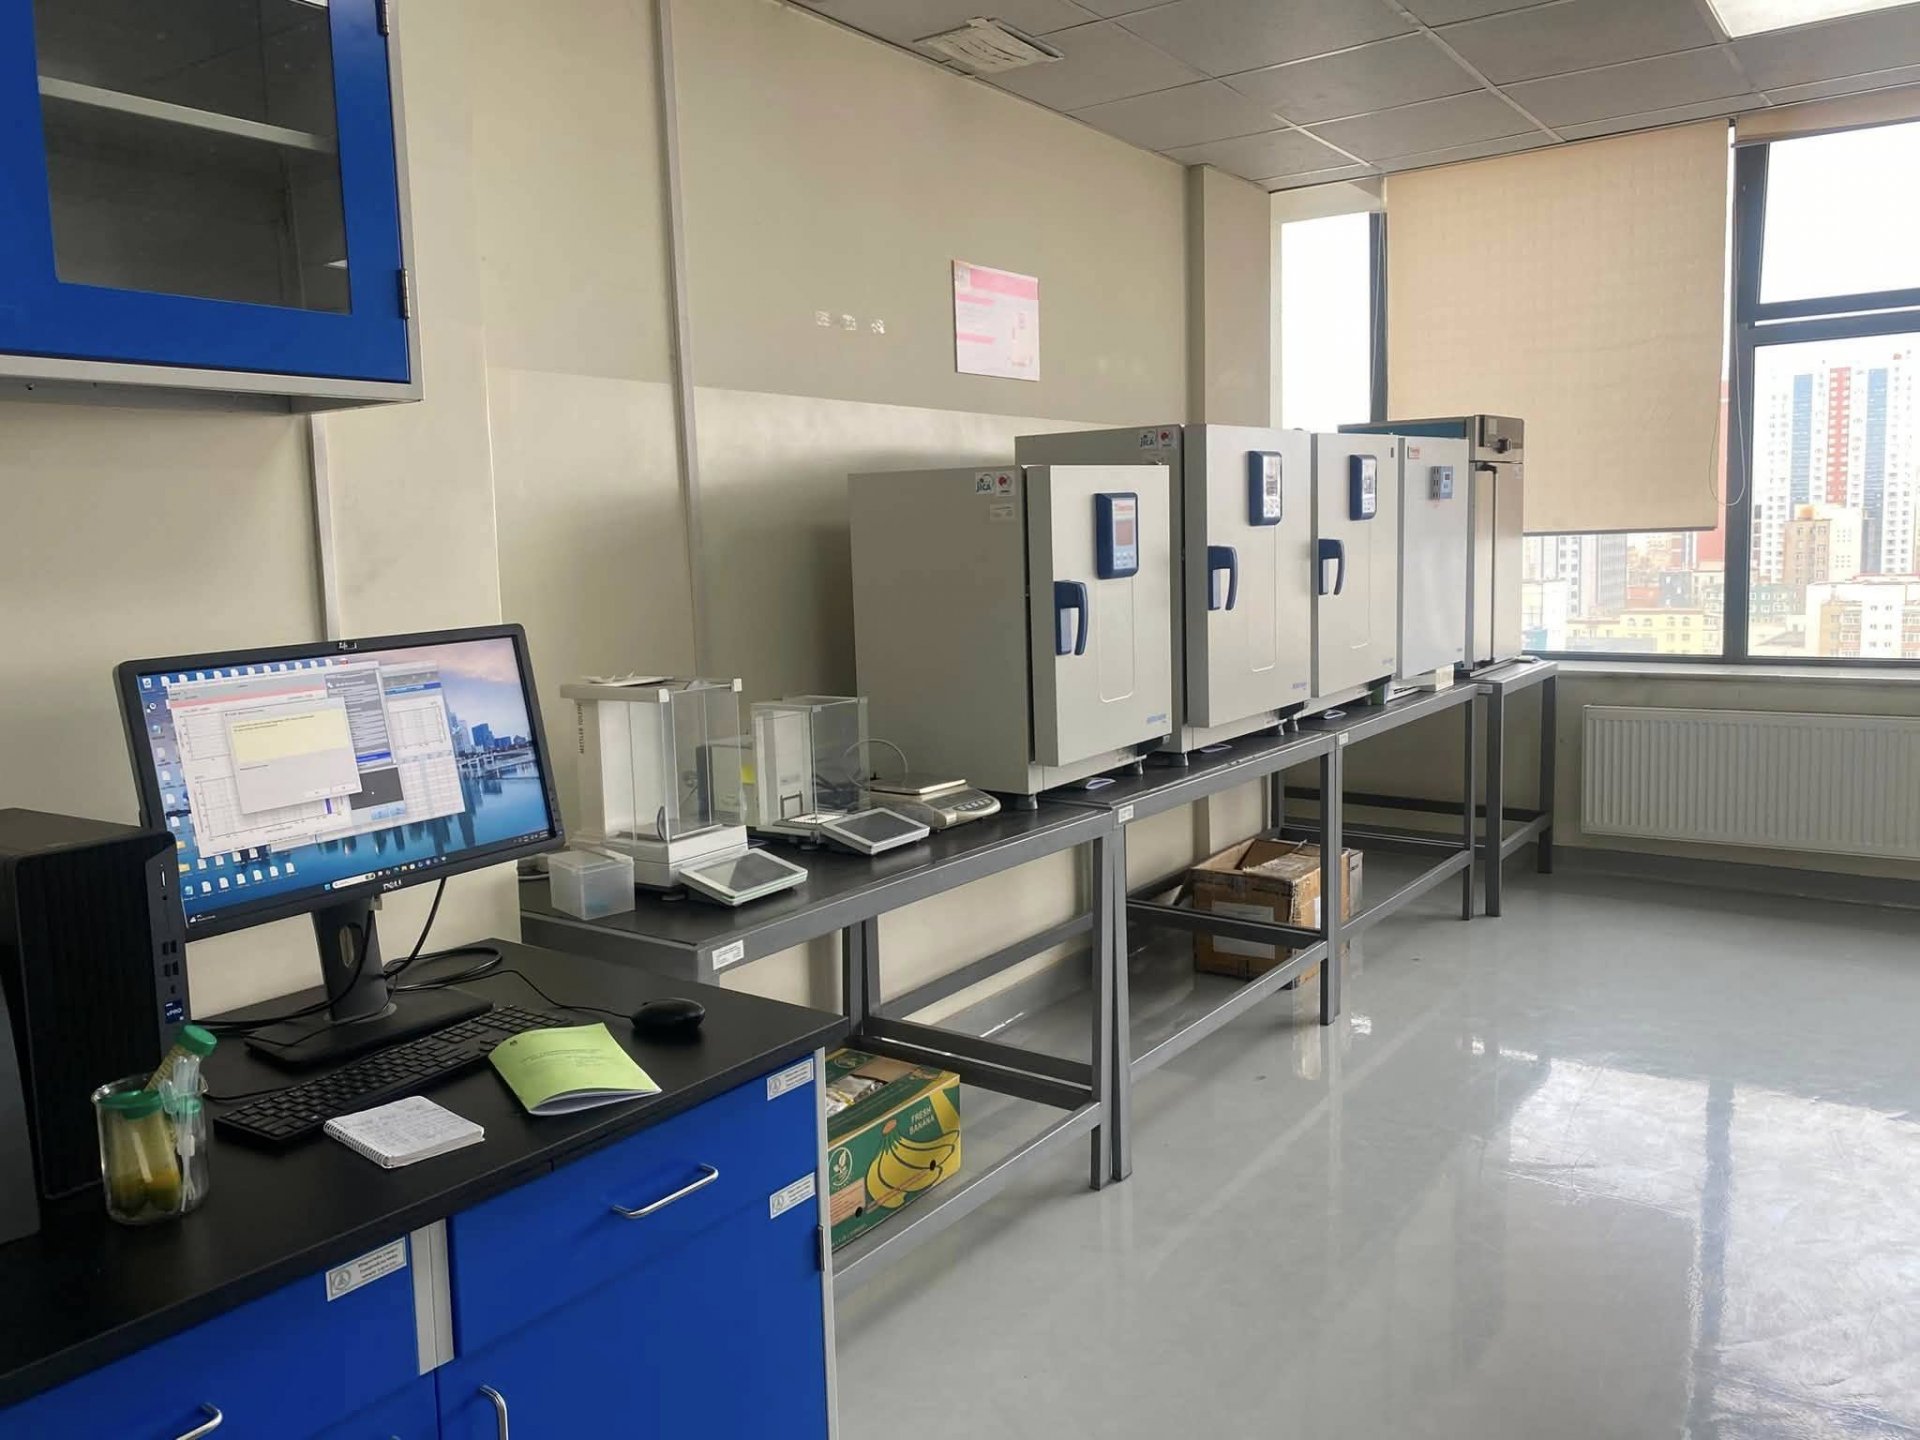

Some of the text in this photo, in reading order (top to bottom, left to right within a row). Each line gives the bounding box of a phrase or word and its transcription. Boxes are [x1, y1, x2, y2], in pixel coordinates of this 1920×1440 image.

[976, 478, 992, 493] JICA
[909, 1113, 935, 1135] BANANA
[911, 1105, 931, 1124] FRESH
